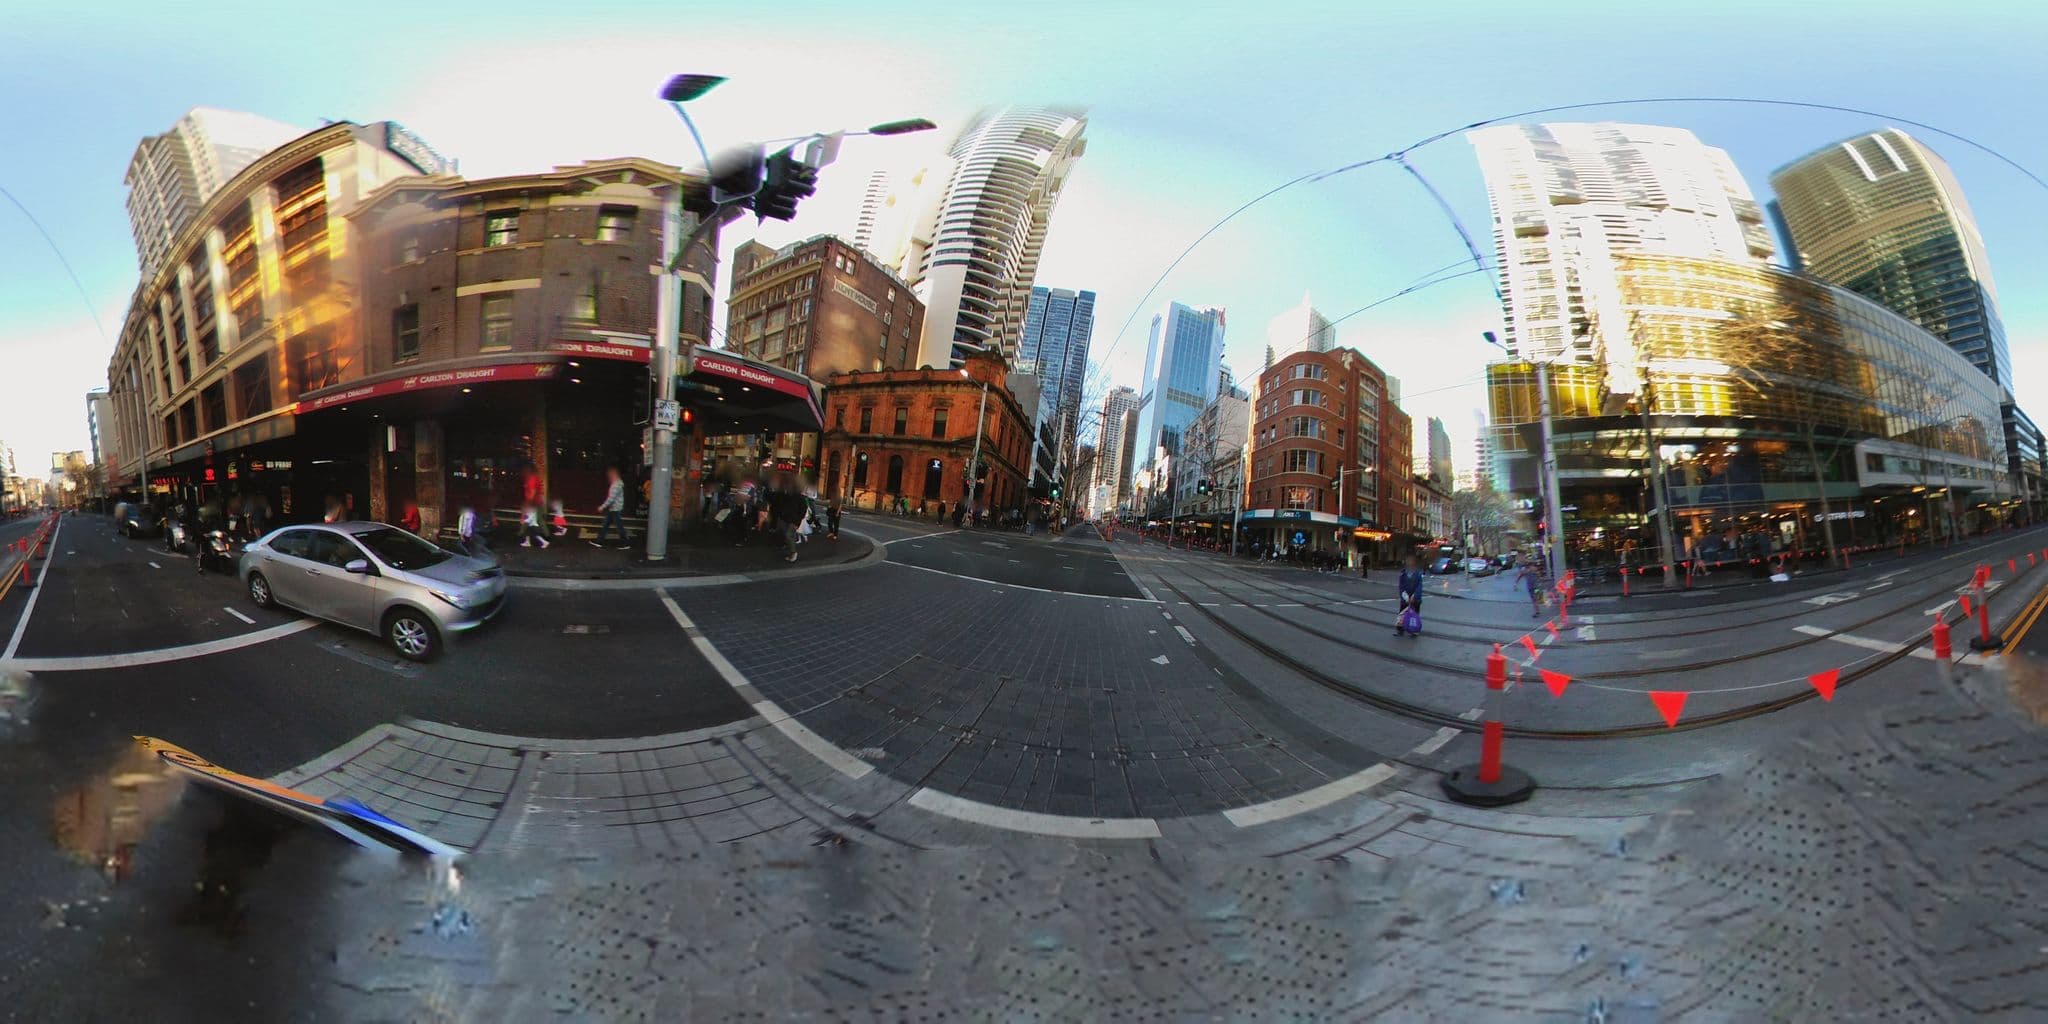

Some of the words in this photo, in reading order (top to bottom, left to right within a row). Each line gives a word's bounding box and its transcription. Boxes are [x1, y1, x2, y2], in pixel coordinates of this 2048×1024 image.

[586, 344, 634, 356] DRAUGHT
[420, 373, 453, 384] CARLTON
[456, 369, 496, 379] DRAUGHT
[701, 360, 738, 374] CARLTON
[740, 369, 775, 384] DRAUGHT
[657, 411, 676, 419] WAY
